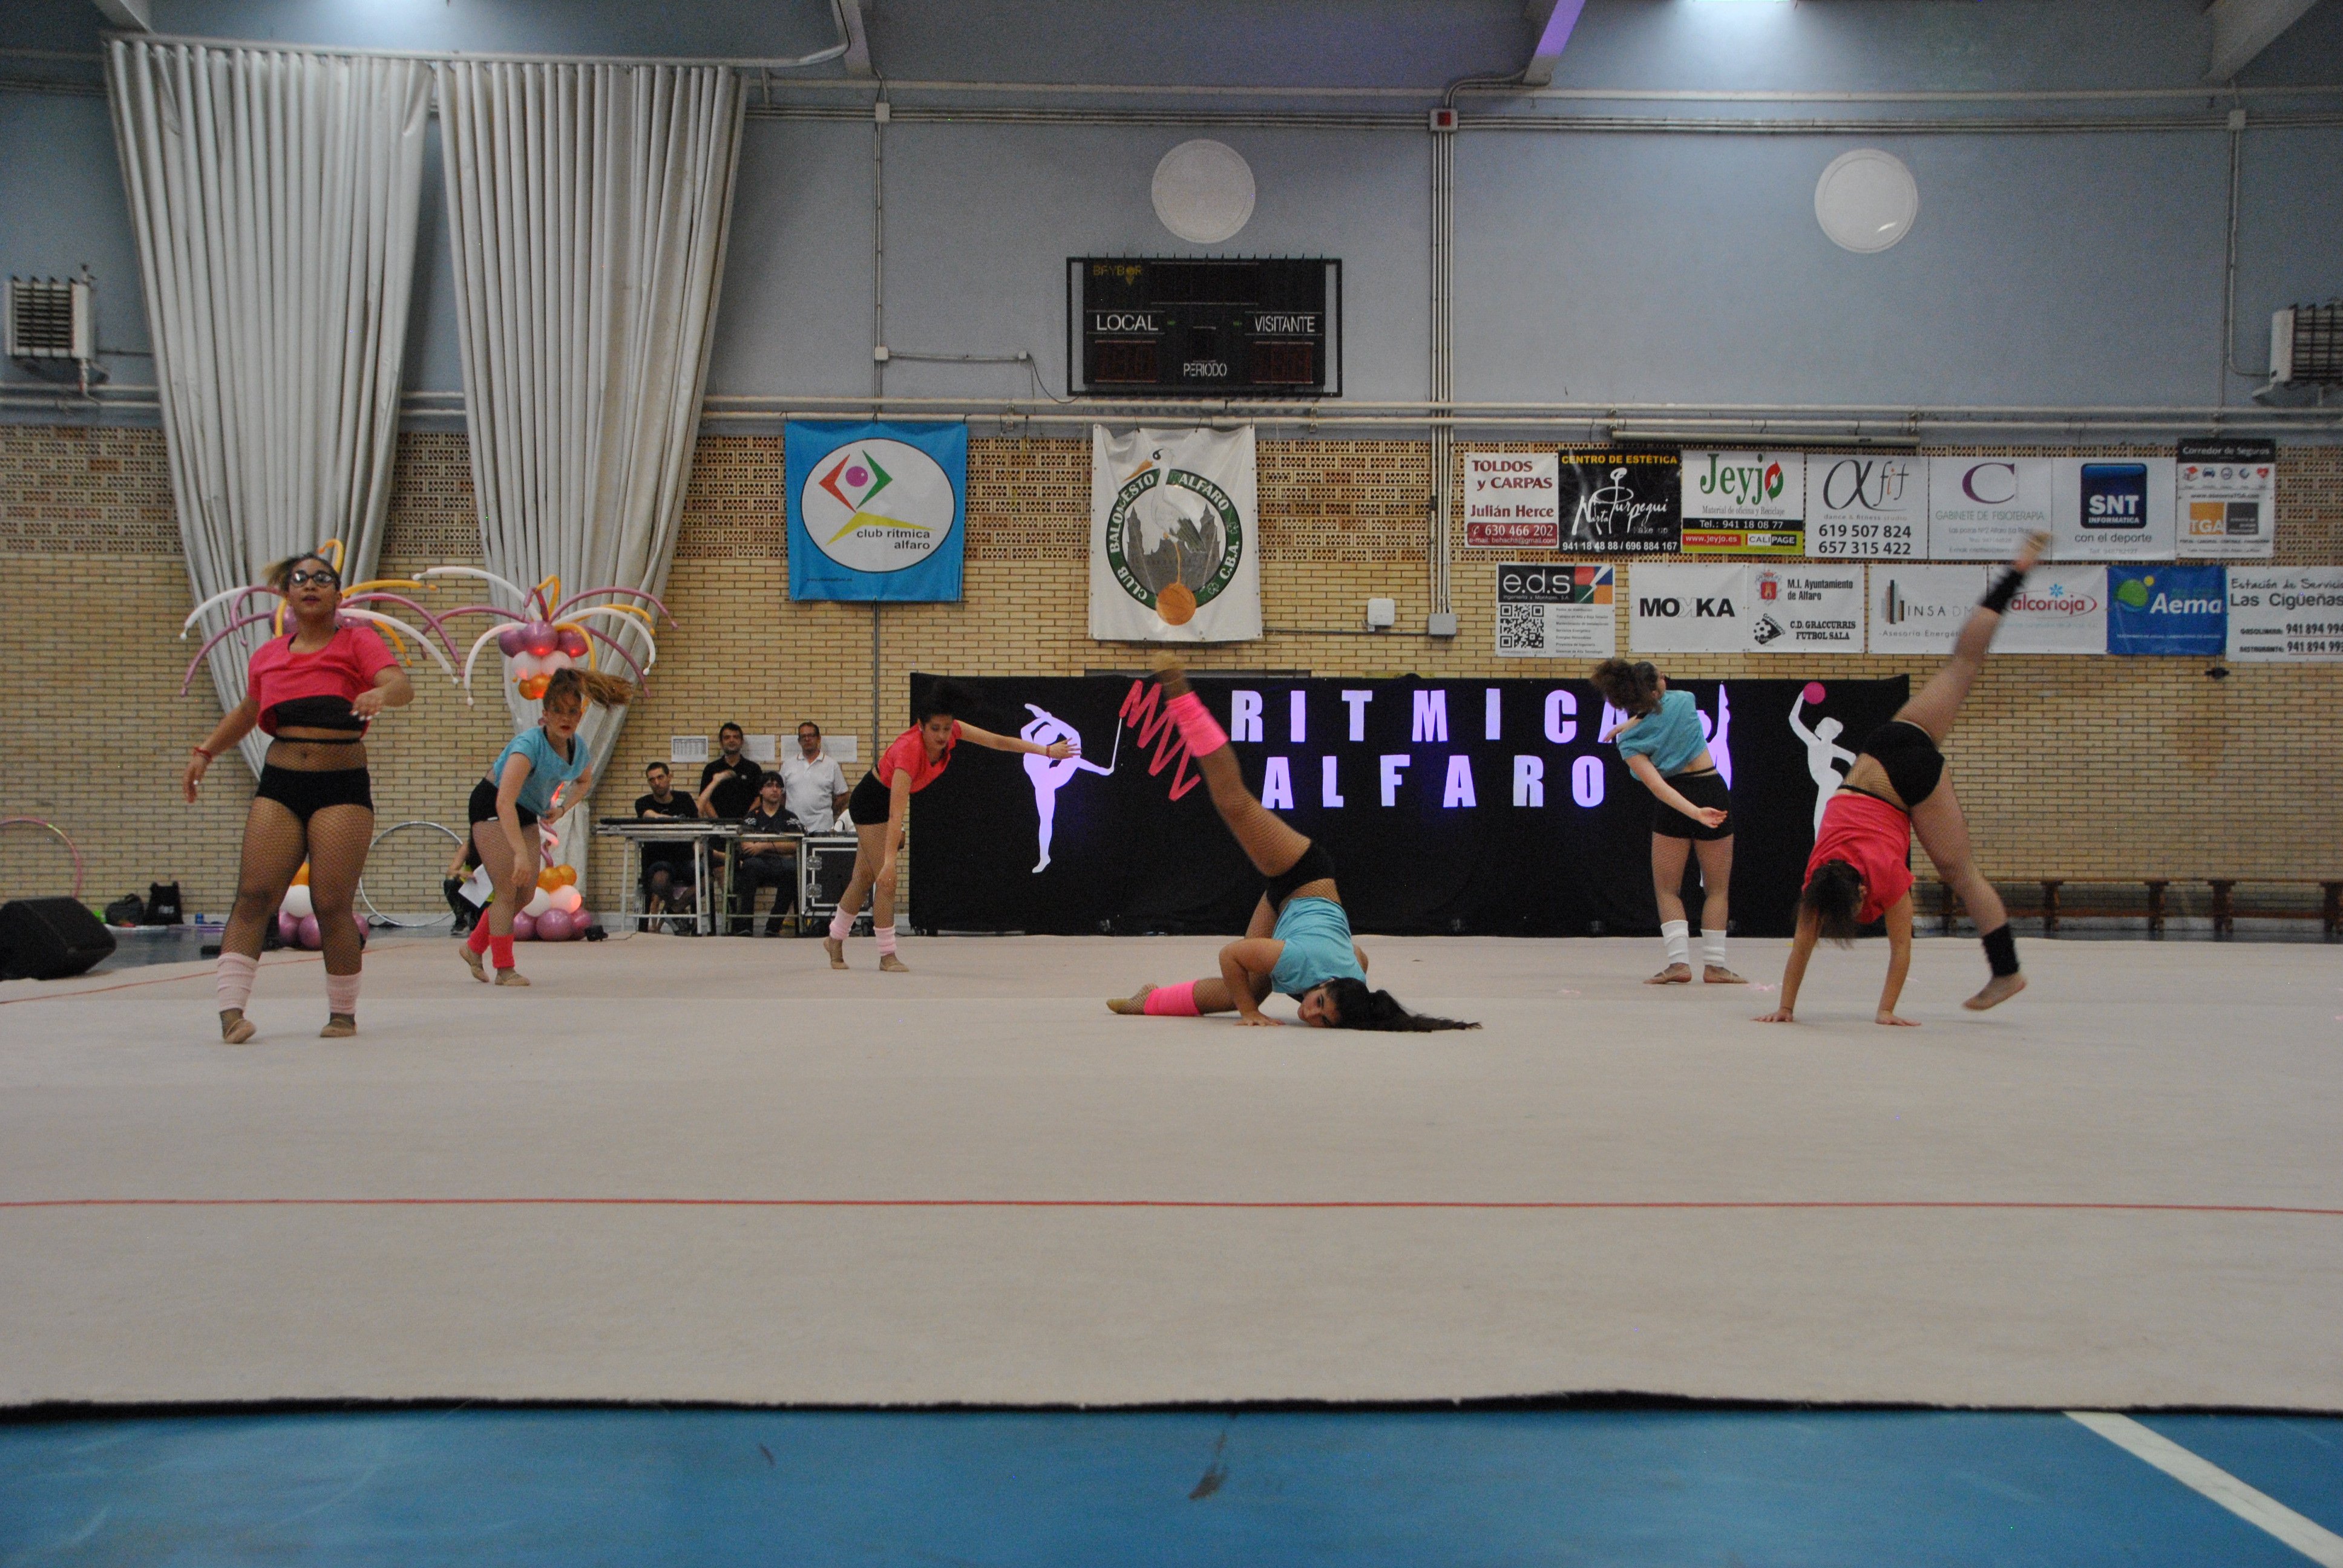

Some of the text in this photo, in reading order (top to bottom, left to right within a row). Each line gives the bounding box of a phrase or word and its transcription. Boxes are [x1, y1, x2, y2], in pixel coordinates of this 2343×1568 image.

[1096, 314, 1159, 331] LOCAL
[1255, 315, 1315, 332] VISITANTE
[1183, 363, 1227, 376] PERIODO
[2236, 446, 2269, 457] Seguros
[1562, 454, 1677, 464] CENTRO DE ESTÉTICA
[1472, 460, 1533, 472] TOLDOS
[1476, 477, 1553, 491] y CARPAS
[1962, 462, 2015, 504] C
[1179, 473, 1230, 511] ALFARO
[1470, 505, 1554, 517] Julián Herce
[1702, 506, 1725, 514] Material
[2089, 495, 2139, 515] SNT
[1935, 511, 1974, 520] GABINETE
[1977, 511, 1988, 520] DE
[1485, 524, 1553, 536] 630 466 202
[1819, 524, 1911, 538] 619 507 824
[2190, 519, 2224, 532] TGA
[857, 528, 930, 538] club rítmica
[1685, 534, 1795, 544] www.jeyjo.es CALIPAGE
[2074, 533, 2152, 544] con el deporte
[894, 540, 930, 550] alfaro
[1562, 542, 1578, 550] 941
[1582, 542, 1592, 550] 18
[1594, 542, 1604, 550] 48
[1607, 542, 1618, 550] 88
[1625, 542, 1642, 550] 696
[1643, 542, 1659, 550] 884
[1662, 542, 1677, 550] 167
[1818, 541, 1910, 555] 657 315 422
[1220, 541, 1239, 580] C.B.A.
[1117, 566, 1148, 600] CLUB
[1503, 569, 1570, 594] e.d.s
[1788, 579, 1853, 590] M.I. Ayuntamiento
[2231, 578, 2277, 589] Estación
[2283, 579, 2296, 589] de
[1788, 591, 1821, 600] de Alfaro
[2230, 593, 2259, 607] Las
[2011, 593, 2085, 615] alcorioja
[2149, 592, 2222, 614] Aema
[1907, 606, 1946, 616] INSA
[1790, 621, 1856, 629] C.D. GRACCURRIS
[2286, 624, 2302, 634] 941
[2305, 624, 2324, 634] 894
[2287, 641, 2304, 652] 941
[2307, 641, 2325, 652] 894
[1231, 688, 1630, 744] RITMICA
[1261, 754, 1605, 809] ALFARO
